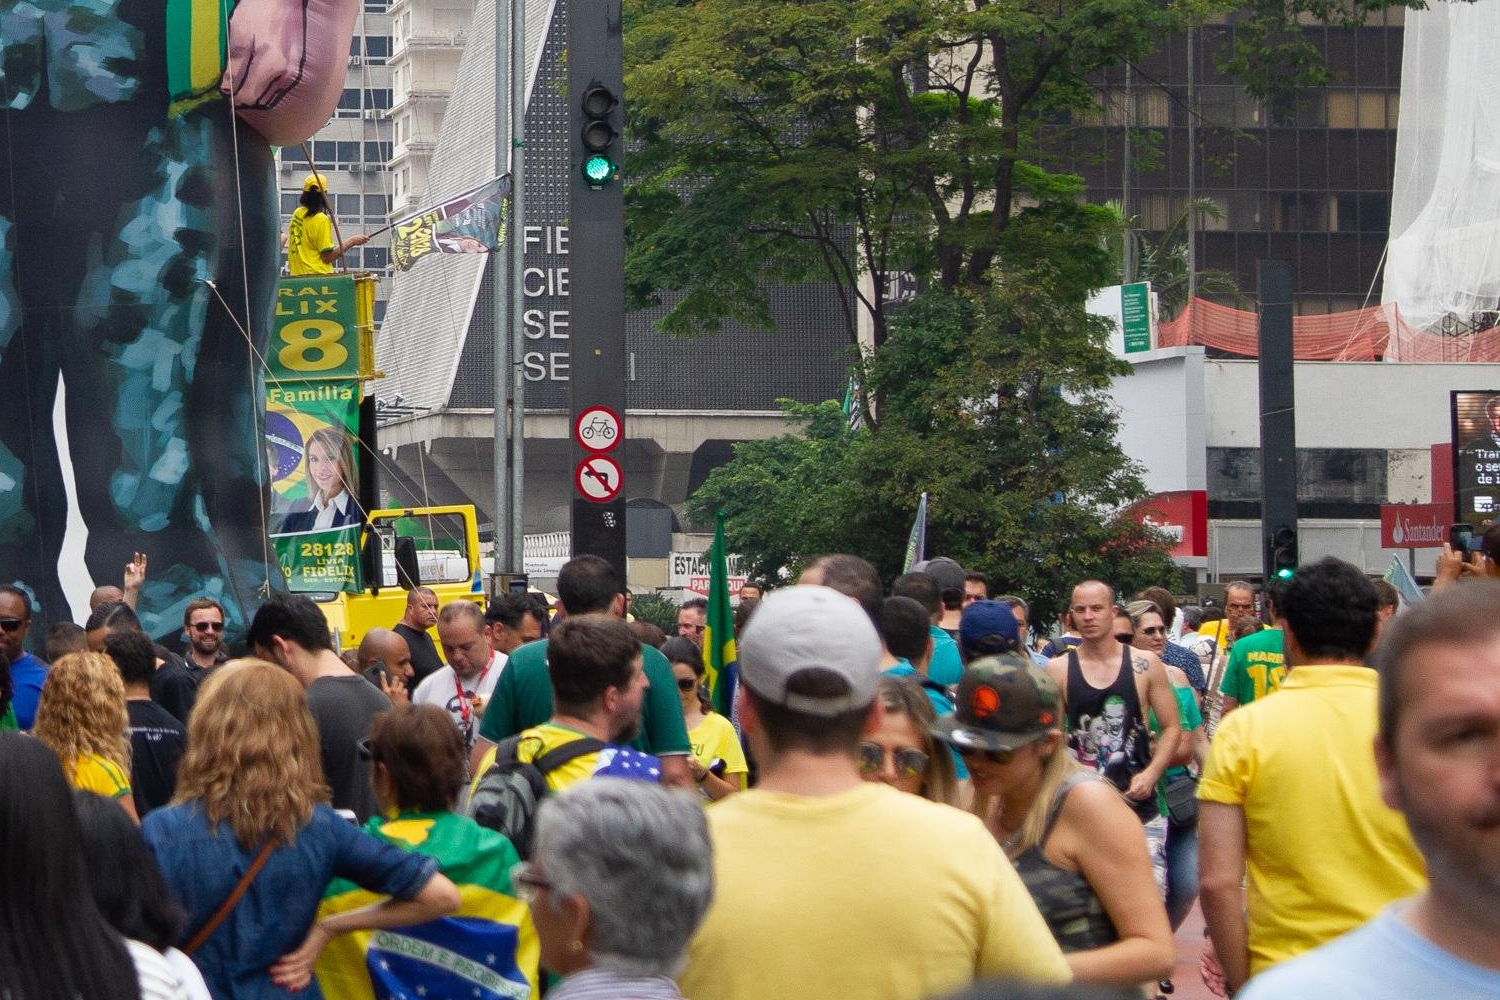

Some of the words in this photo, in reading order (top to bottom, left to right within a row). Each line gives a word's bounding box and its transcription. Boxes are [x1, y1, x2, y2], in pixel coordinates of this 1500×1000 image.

[278, 319, 348, 371] 8
[1404, 515, 1445, 543] Santander
[301, 543, 354, 557] 28128
[303, 564, 355, 577] FIDELIX
[377, 934, 433, 960] ORDEM
